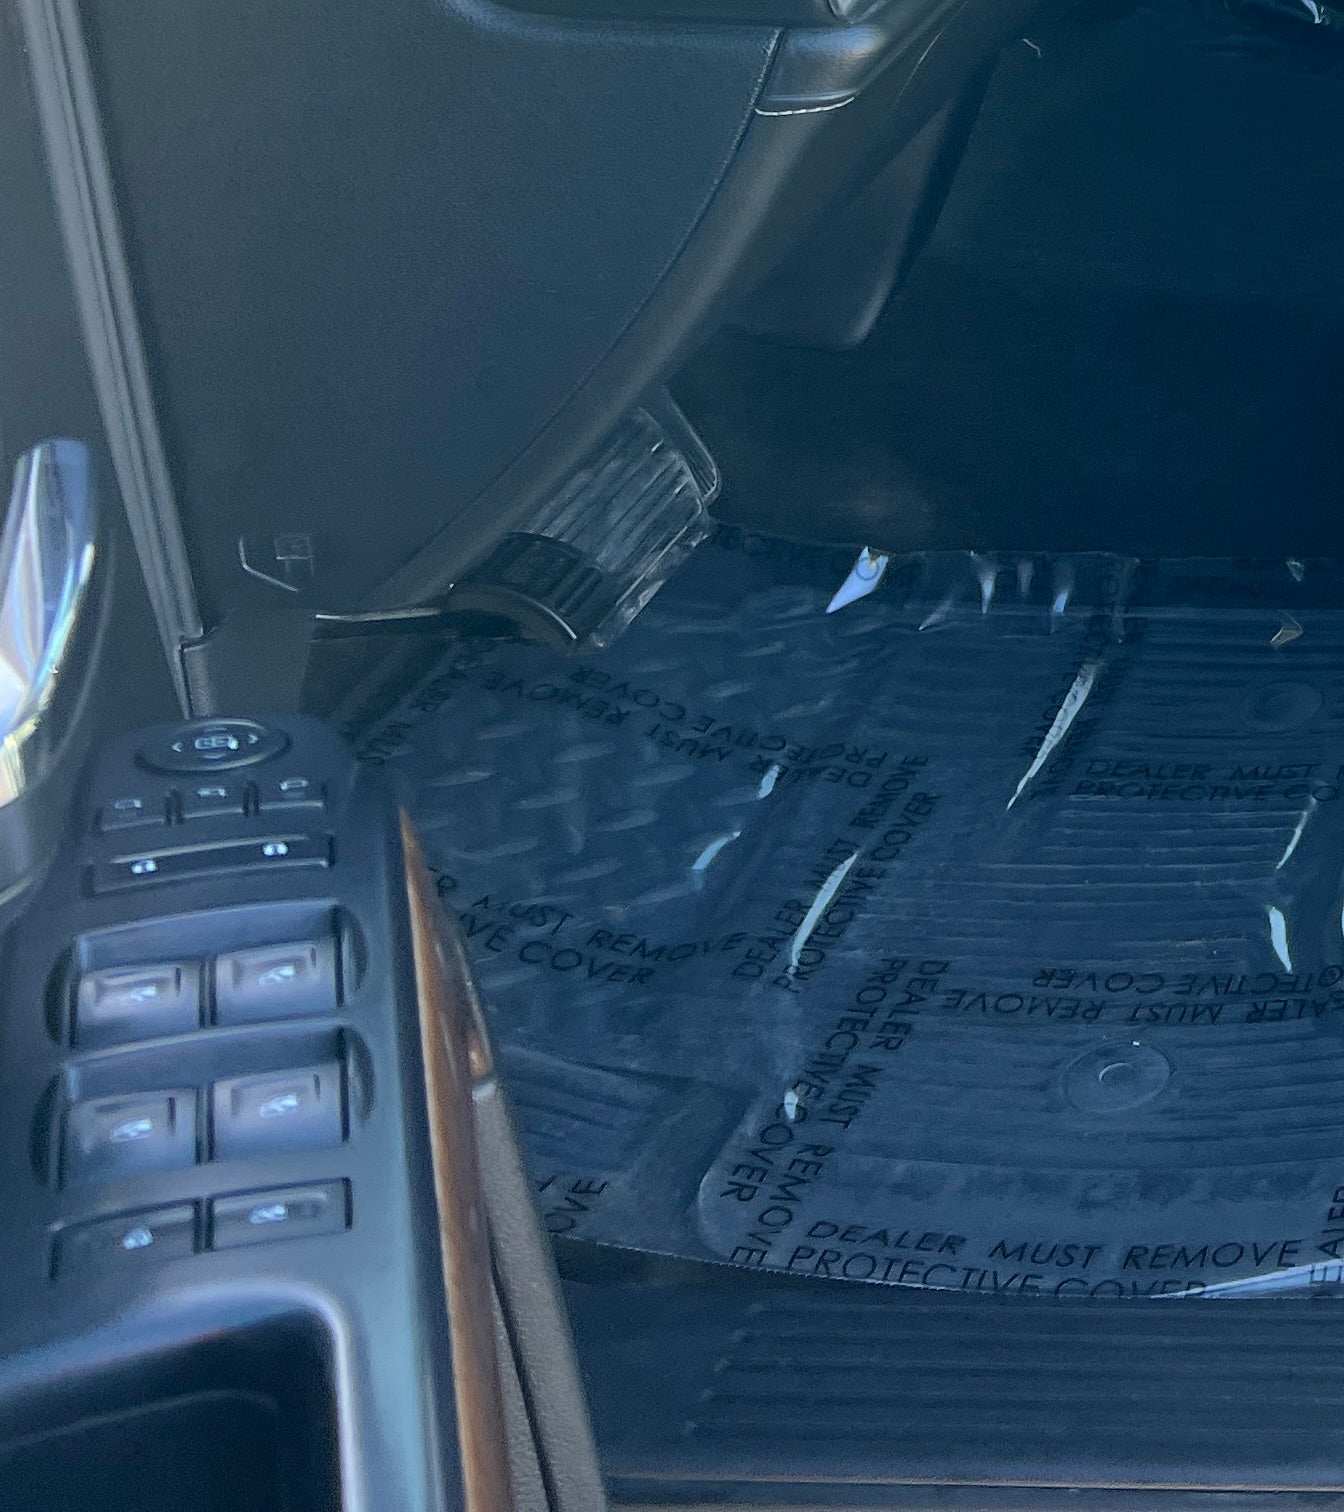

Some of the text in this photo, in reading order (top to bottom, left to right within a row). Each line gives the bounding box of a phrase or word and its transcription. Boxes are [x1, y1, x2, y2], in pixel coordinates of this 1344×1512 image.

[645, 723, 734, 762] MUST
[1086, 758, 1211, 778] DEALER
[1232, 762, 1325, 781] MUST
[871, 791, 943, 862] COVER
[586, 928, 748, 963] REMOVE
[730, 898, 806, 979] DEALER
[518, 940, 655, 985] COVER
[1031, 967, 1165, 993] COVER
[943, 987, 1106, 1025] REMOVE
[1124, 1000, 1224, 1025] MUST
[720, 957, 908, 1203] PROTECTIVE COVER
[730, 959, 950, 1266] DEALER MUST REMOVE
[806, 1220, 1304, 1271] DEALER MUST REMOVE
[788, 1245, 1043, 1296] PROTECTIVE
